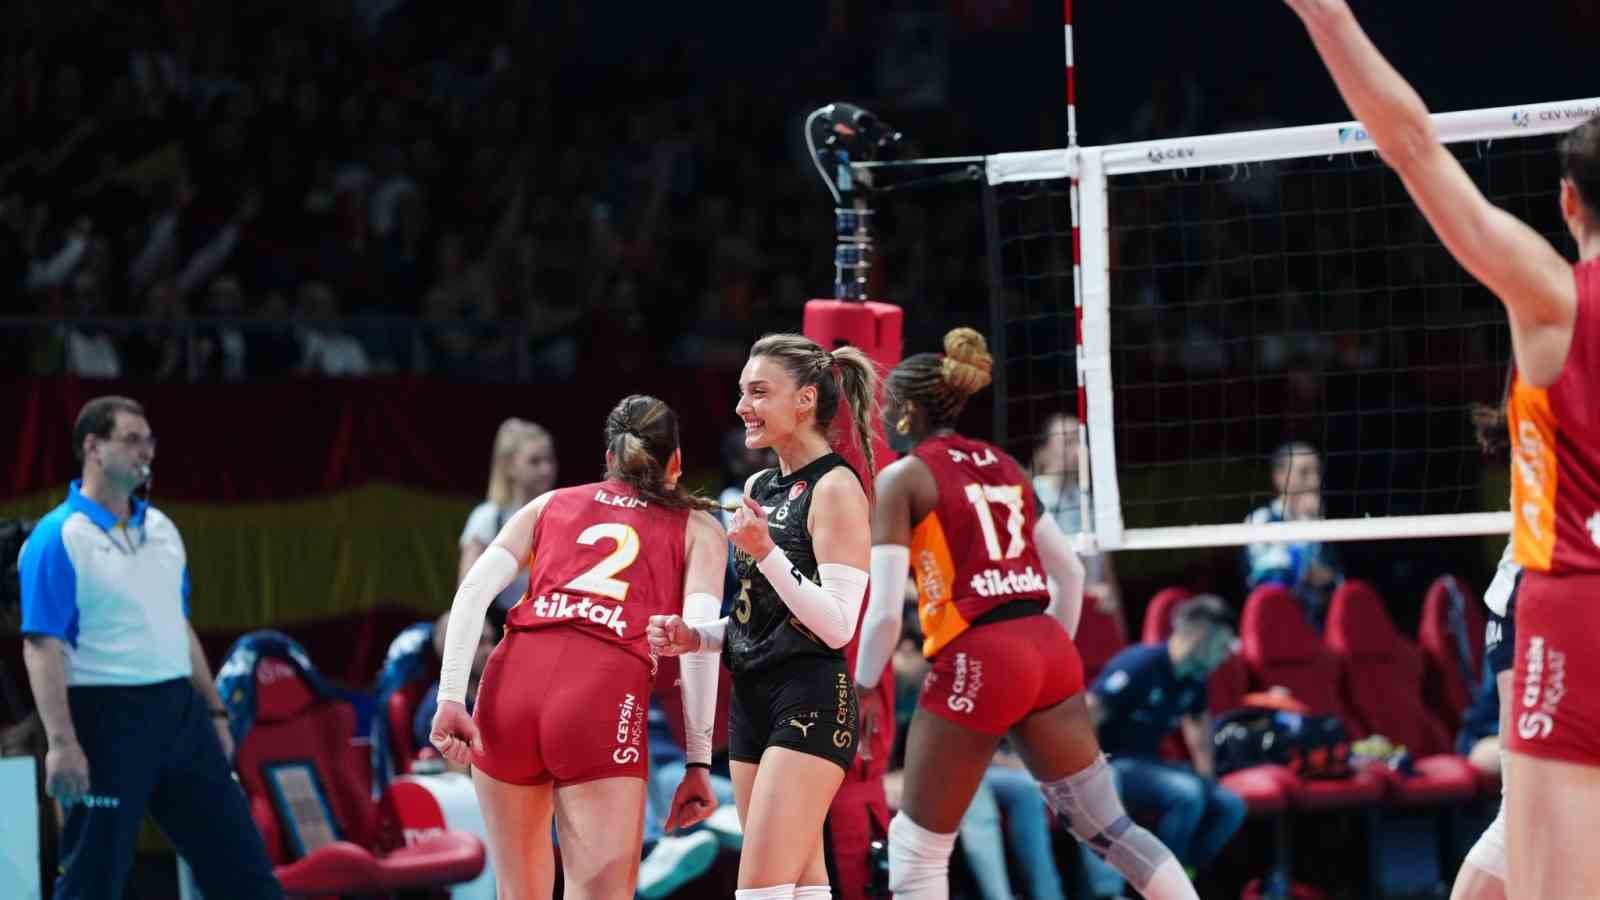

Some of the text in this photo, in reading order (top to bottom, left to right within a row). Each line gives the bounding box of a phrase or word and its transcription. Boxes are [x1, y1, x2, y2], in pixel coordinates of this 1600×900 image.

[964, 482, 1025, 561] 17
[563, 522, 641, 601] 2
[970, 566, 1047, 597] tiktak
[533, 592, 628, 637] tiktak
